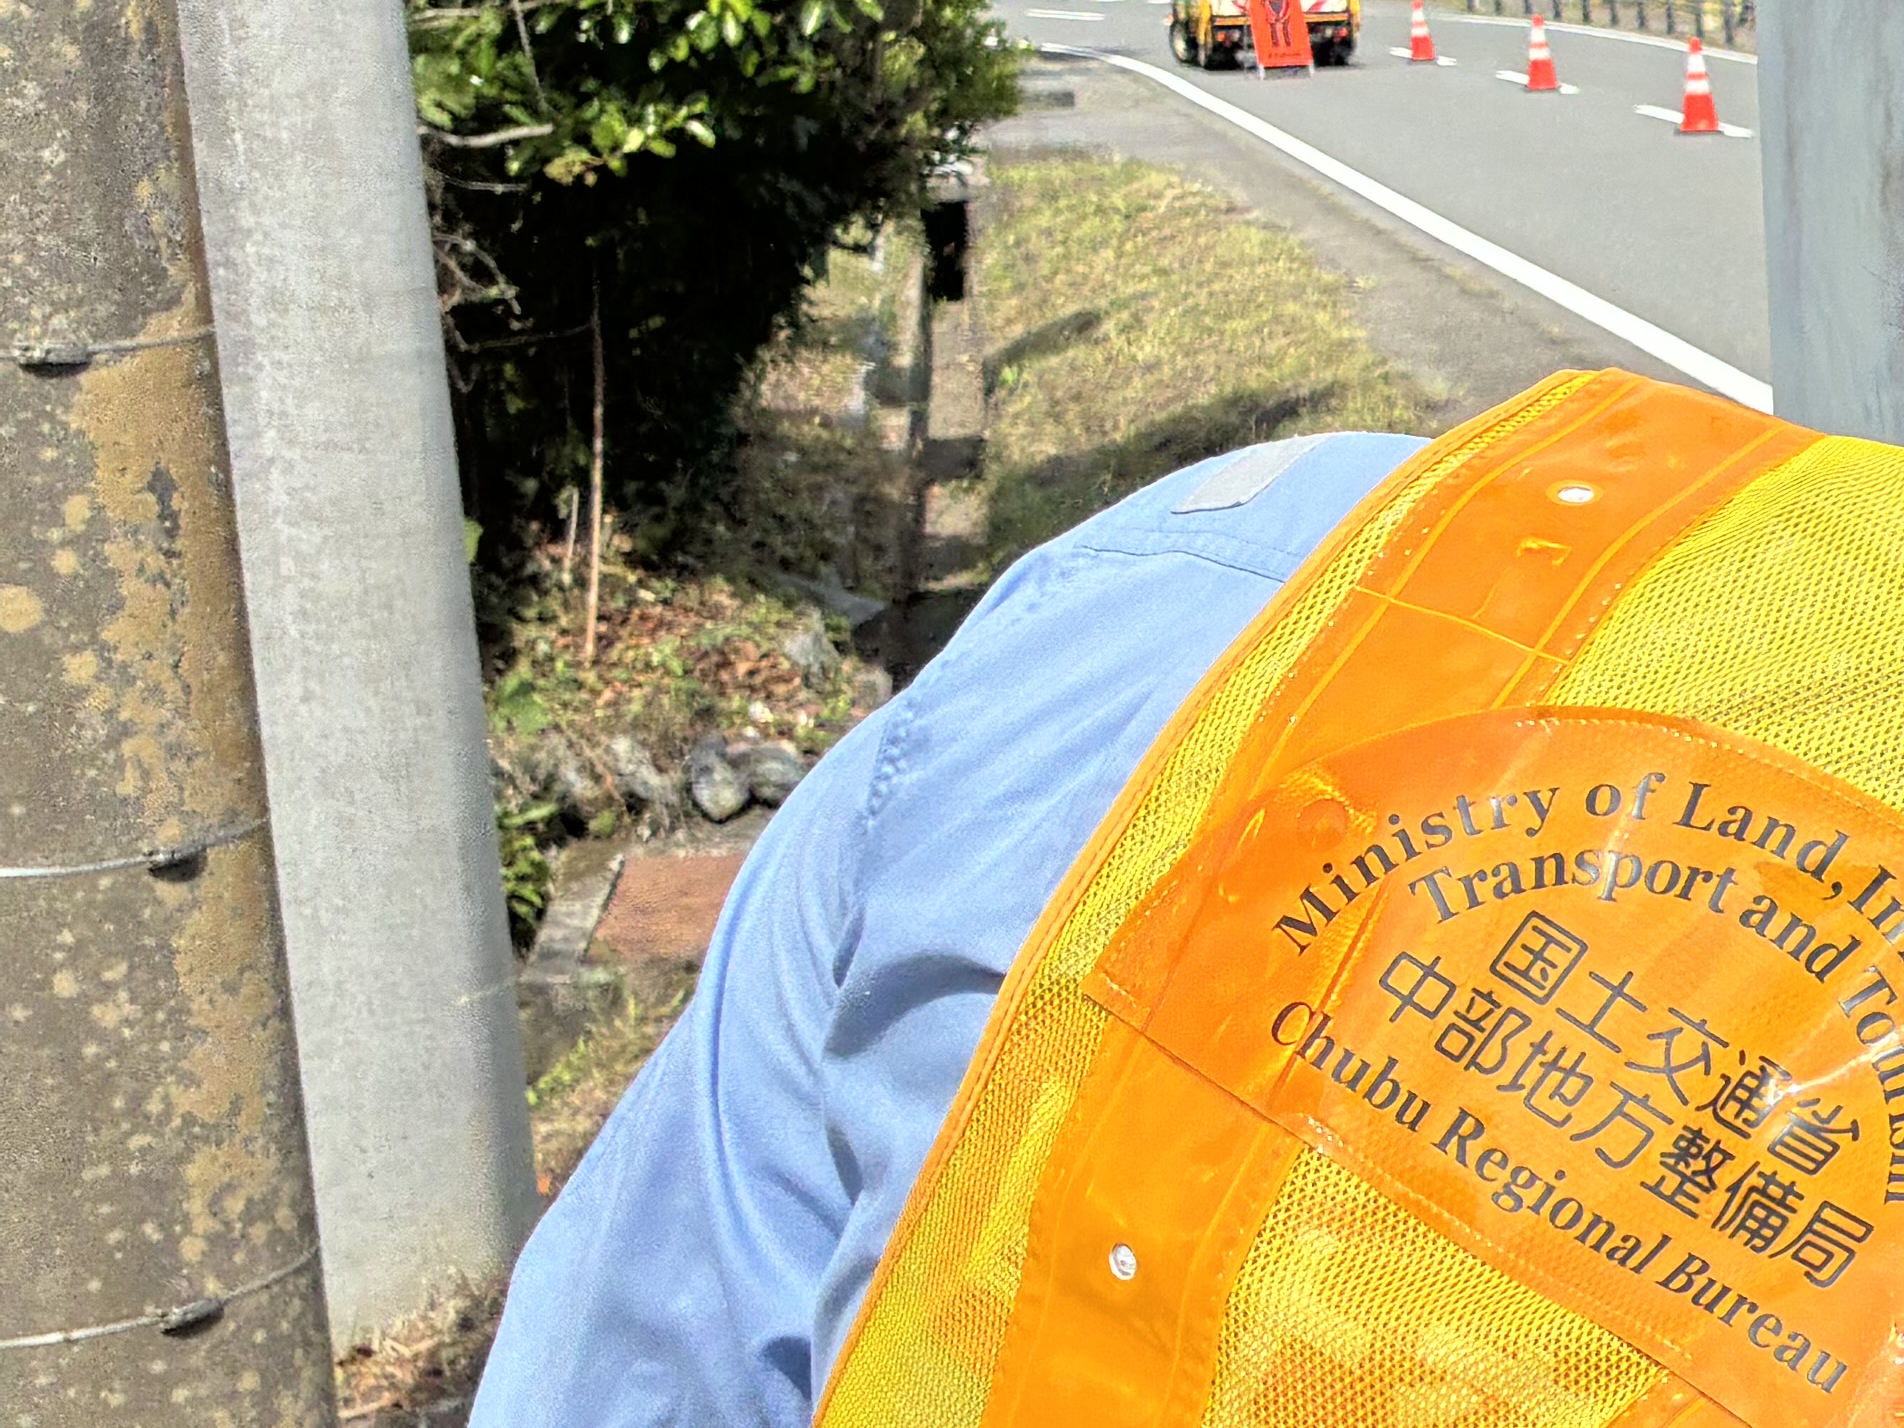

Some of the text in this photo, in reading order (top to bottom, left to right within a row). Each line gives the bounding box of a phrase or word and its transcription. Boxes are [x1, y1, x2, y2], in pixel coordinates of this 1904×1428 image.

[1271, 785, 1561, 956] Ministry
[1584, 771, 1666, 821] of
[1672, 780, 1850, 902] Land,
[1408, 844, 1738, 925] Transport
[1738, 891, 1862, 985] and
[1378, 950, 1875, 1289] 中部地方整備局
[1489, 910, 1860, 1176] 国土交通省
[1270, 1000, 1849, 1395] Chubu Regional Bureau
